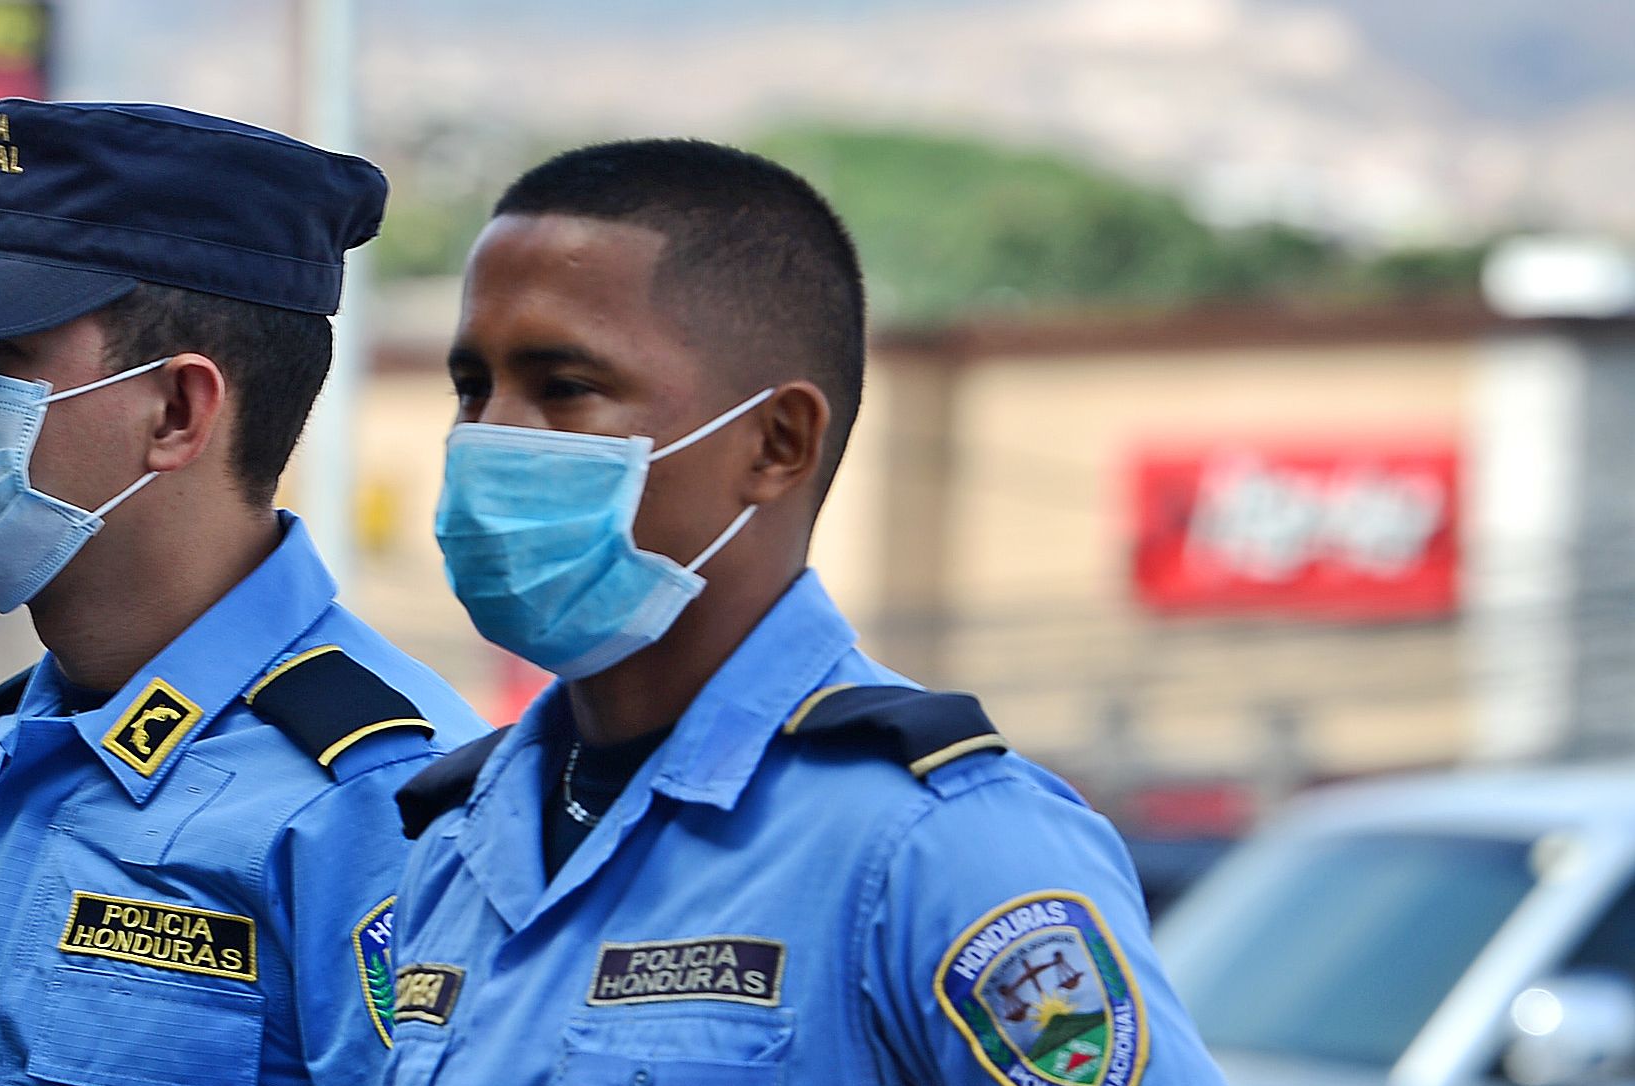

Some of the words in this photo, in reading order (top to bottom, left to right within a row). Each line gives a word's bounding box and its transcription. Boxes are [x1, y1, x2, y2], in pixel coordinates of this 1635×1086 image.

[101, 904, 214, 943] POLICIA
[952, 900, 1069, 981] HONDURAS
[73, 925, 243, 971] HONDURAS
[627, 944, 738, 972] POLICIA
[599, 966, 767, 997] HONDURAS
